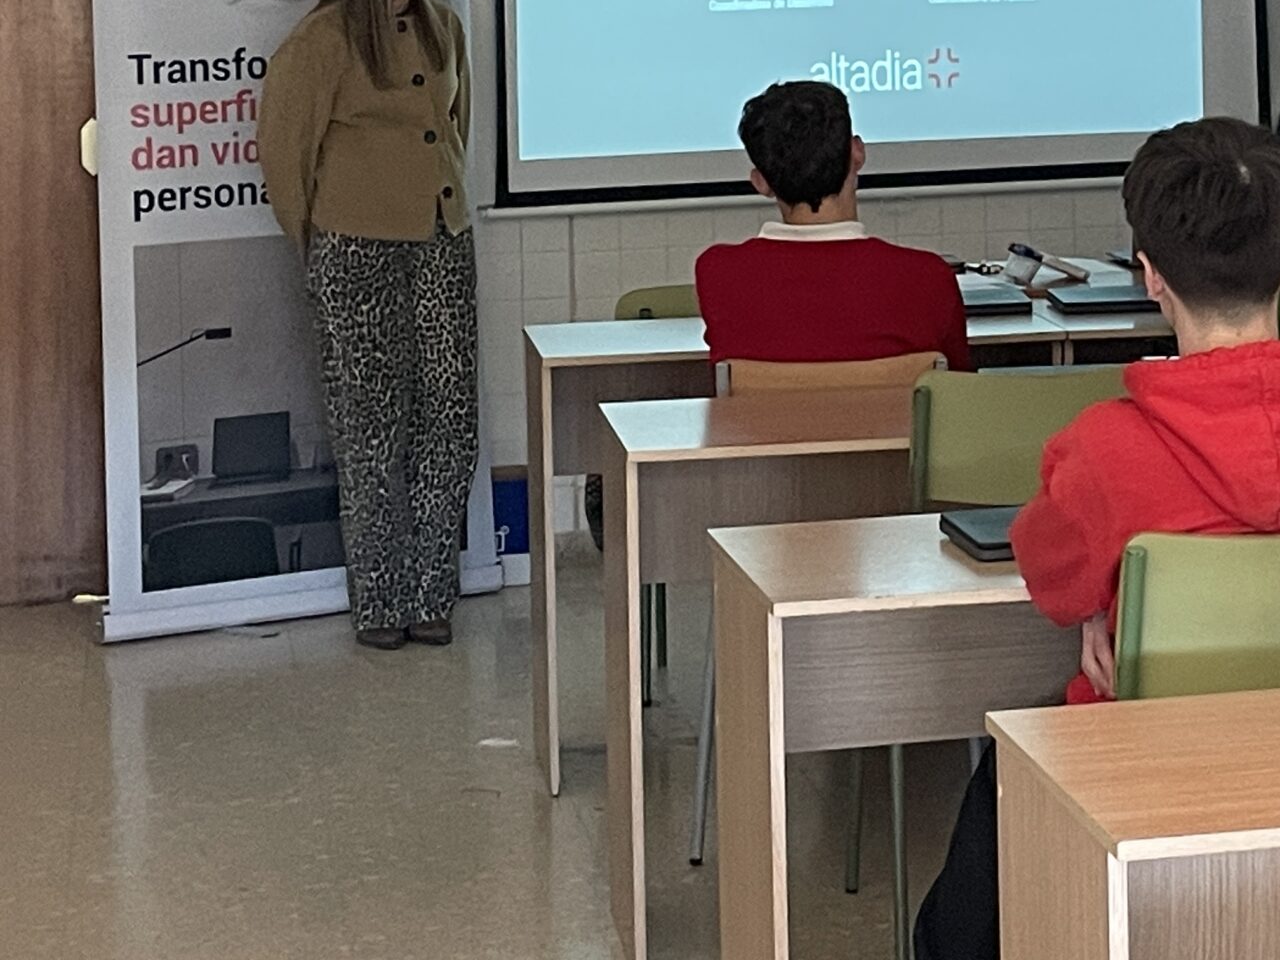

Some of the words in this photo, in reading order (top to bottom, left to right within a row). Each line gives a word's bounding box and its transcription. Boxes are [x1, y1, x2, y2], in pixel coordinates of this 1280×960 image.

[127, 47, 268, 85] Transfo
[810, 48, 922, 92] altadia
[131, 136, 199, 171] dan
